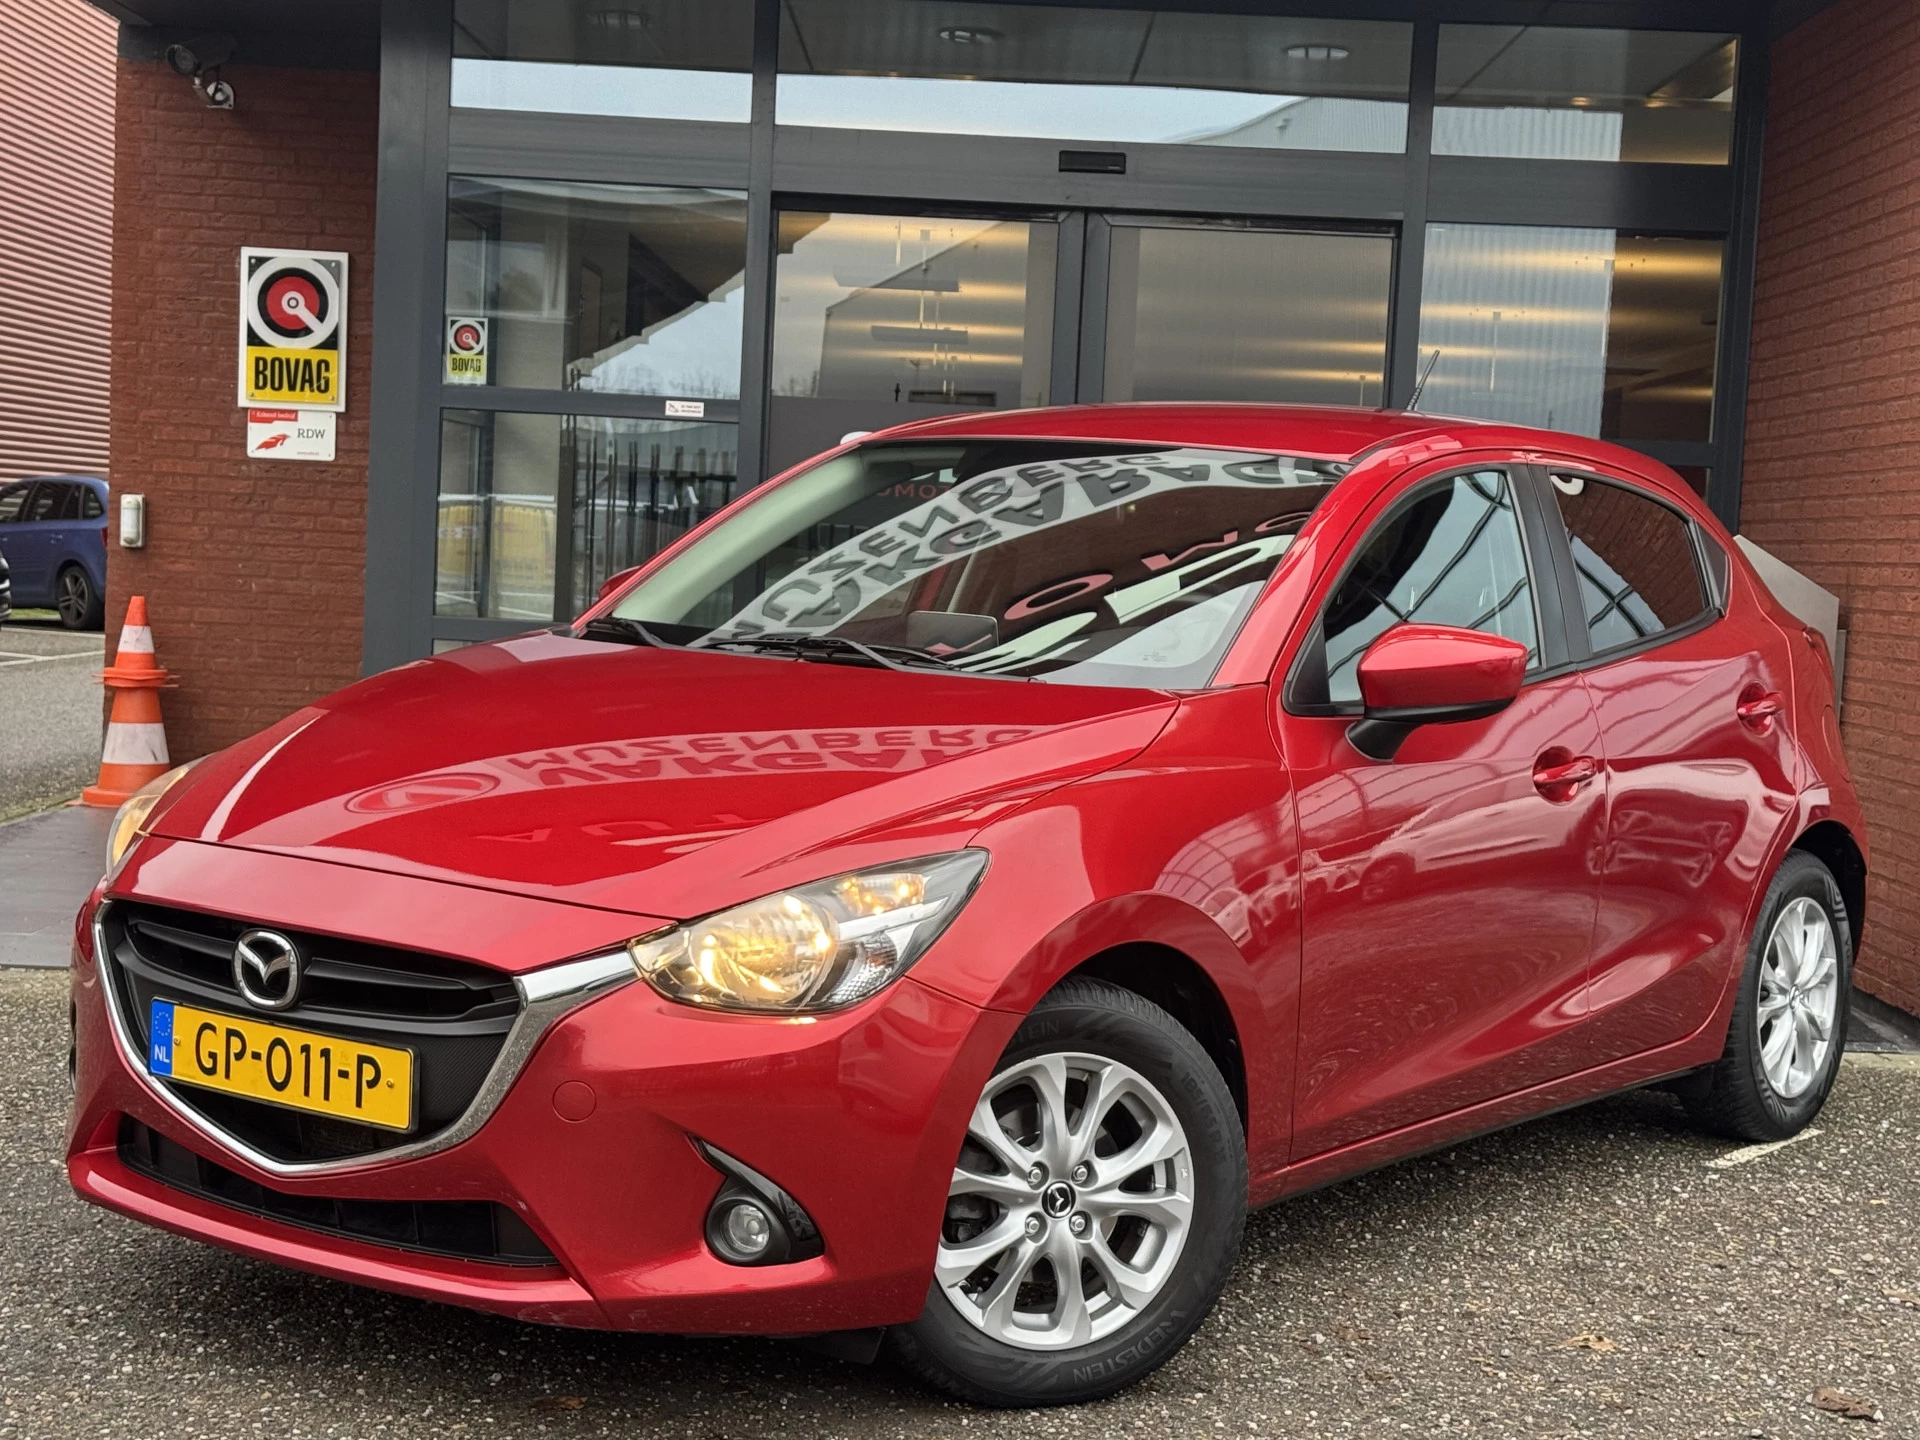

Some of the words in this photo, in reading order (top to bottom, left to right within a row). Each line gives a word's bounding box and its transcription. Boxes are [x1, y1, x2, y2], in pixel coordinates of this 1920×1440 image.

[253, 356, 331, 394] BOVAG
[451, 358, 482, 373] BOVAG
[297, 428, 326, 439] RDW
[154, 1044, 170, 1063] NL
[195, 1021, 382, 1108] GP-011-P
